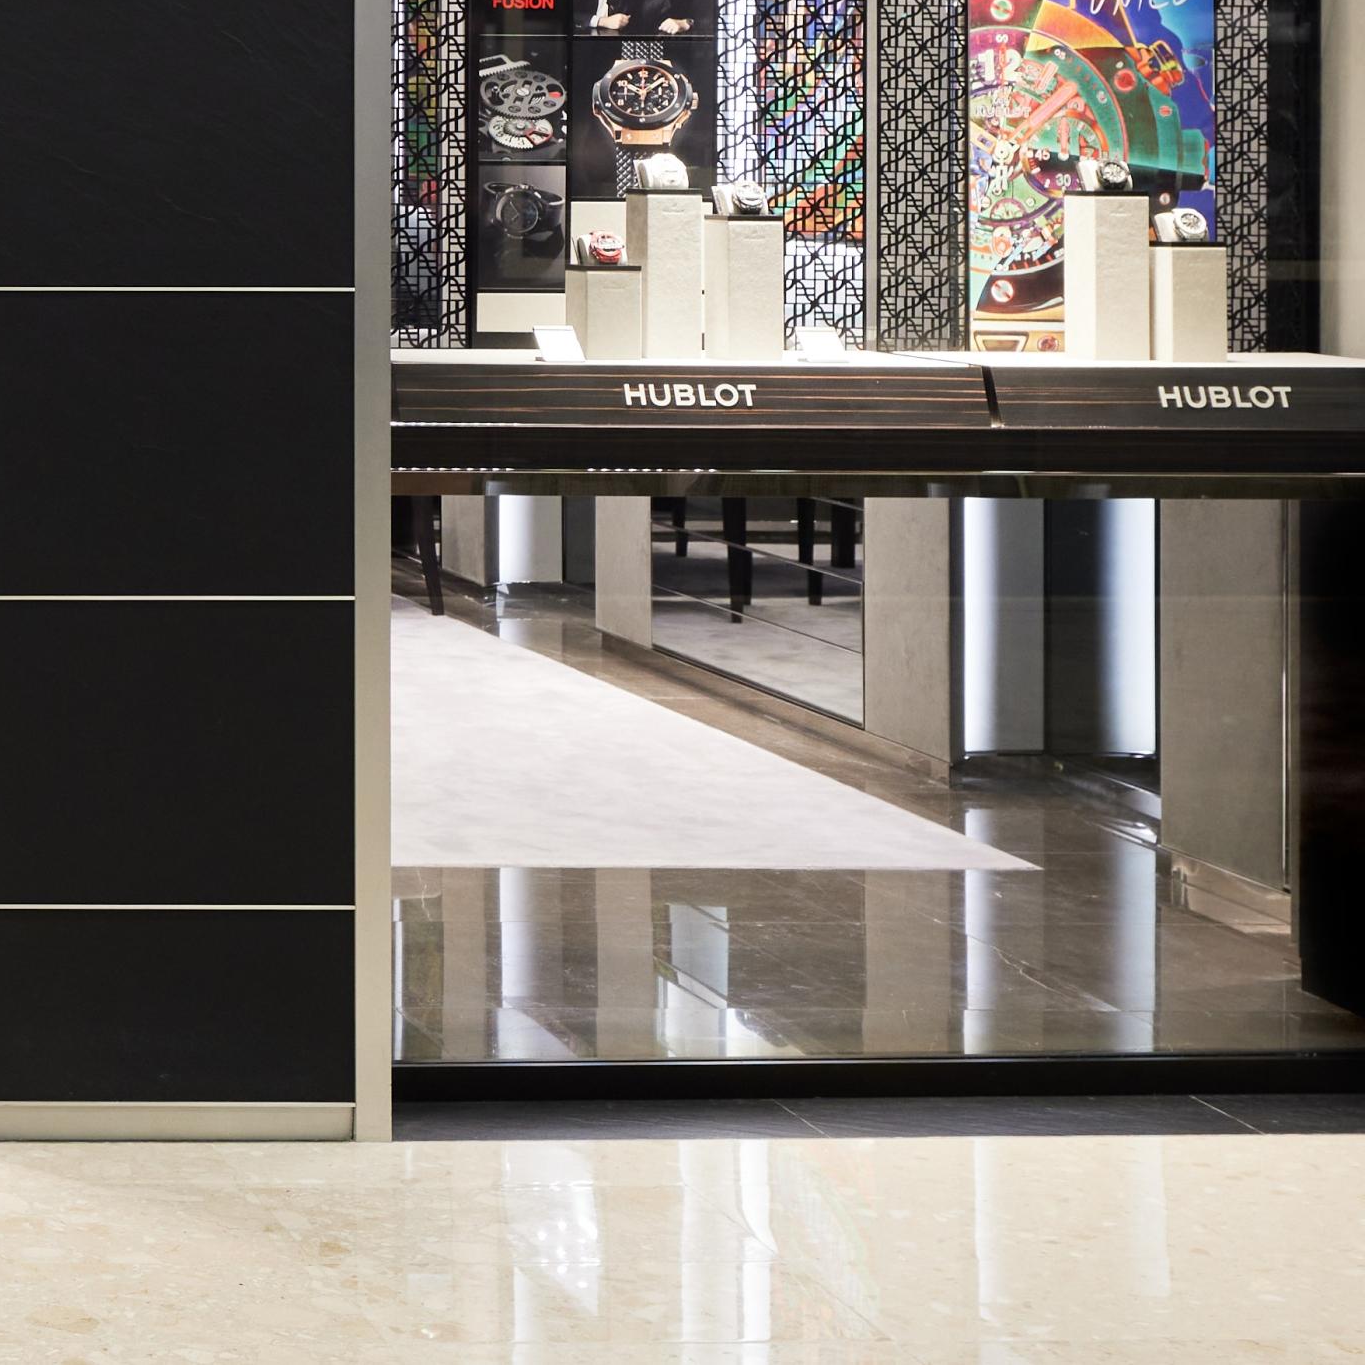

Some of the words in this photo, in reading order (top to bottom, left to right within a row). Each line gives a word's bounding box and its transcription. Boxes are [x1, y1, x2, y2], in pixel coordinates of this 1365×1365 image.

[1055, 173, 1072, 187] 30
[623, 382, 757, 407] HUBLOT
[1157, 385, 1293, 409] HUBLOT
